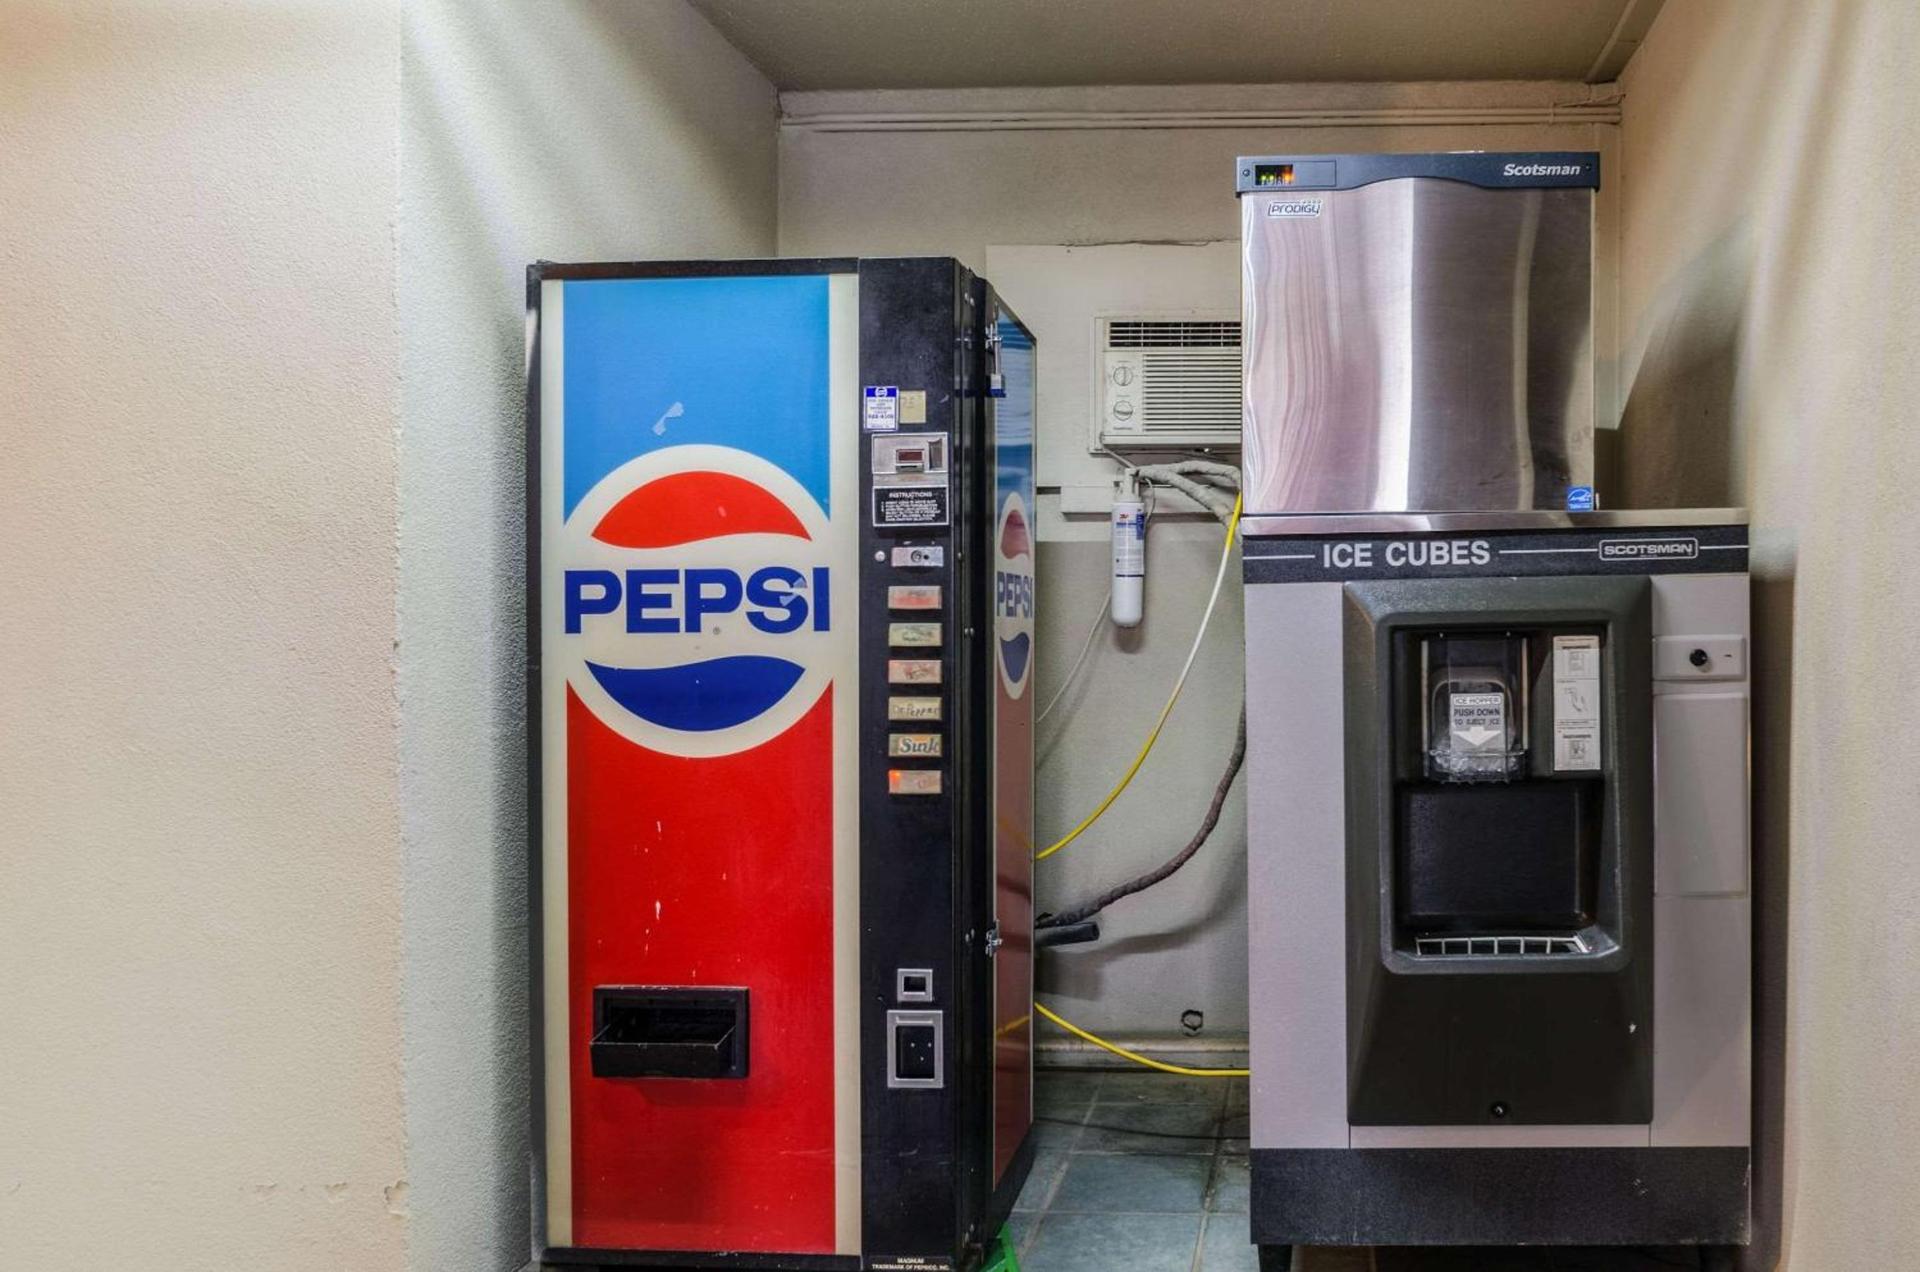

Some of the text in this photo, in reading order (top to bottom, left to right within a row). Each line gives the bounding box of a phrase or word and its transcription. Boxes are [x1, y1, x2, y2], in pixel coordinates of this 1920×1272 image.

[1503, 163, 1581, 176] Scotsman
[889, 491, 933, 499] INSTRUCTIONS
[1323, 540, 1491, 568] ICE CUBES
[1603, 543, 1693, 556] SCOTSMAN
[564, 566, 830, 635] PEPSI
[997, 571, 1033, 619] PEPSI
[1455, 697, 1467, 705] ICE
[1454, 708, 1500, 717] PUSH DOWN
